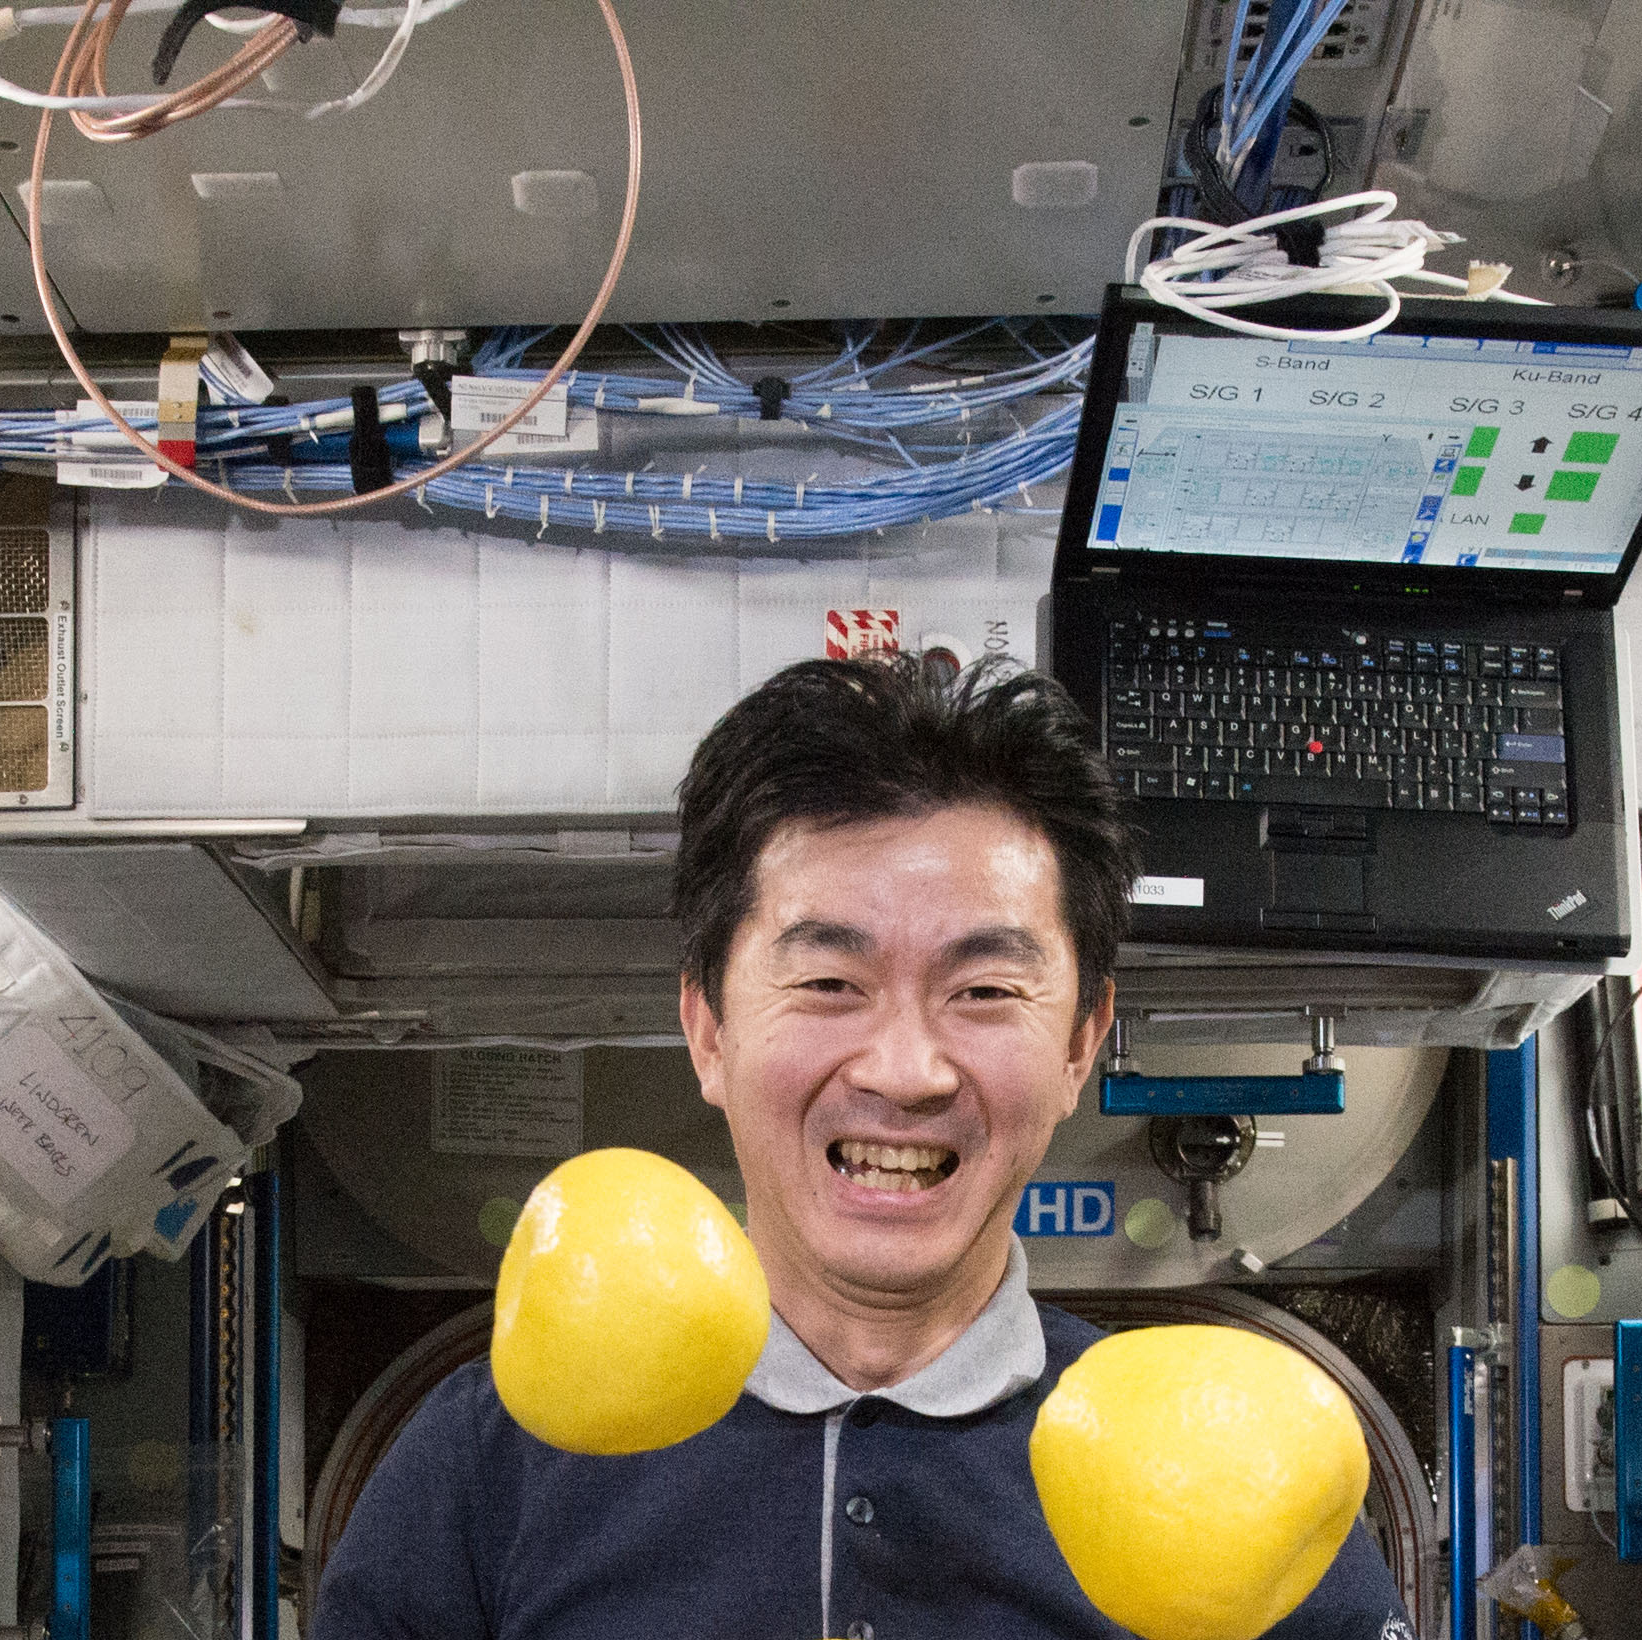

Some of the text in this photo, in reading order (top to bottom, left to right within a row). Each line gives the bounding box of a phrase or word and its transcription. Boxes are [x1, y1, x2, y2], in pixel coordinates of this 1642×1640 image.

[1255, 355, 1331, 371] S-Band
[1512, 369, 1602, 385] Ku-Band
[1189, 384, 1263, 402] S/G 1
[1309, 390, 1386, 408] S/G 2
[1449, 397, 1525, 415] S/G 3
[1567, 403, 1618, 421] S/G
[1450, 513, 1490, 526] LAN
[54, 614, 68, 739] Exhaust Outlet Screen
[1547, 889, 1587, 922] ThinkPad
[518, 1052, 562, 1065] HATCH
[19, 1070, 100, 1147] LINDGREN
